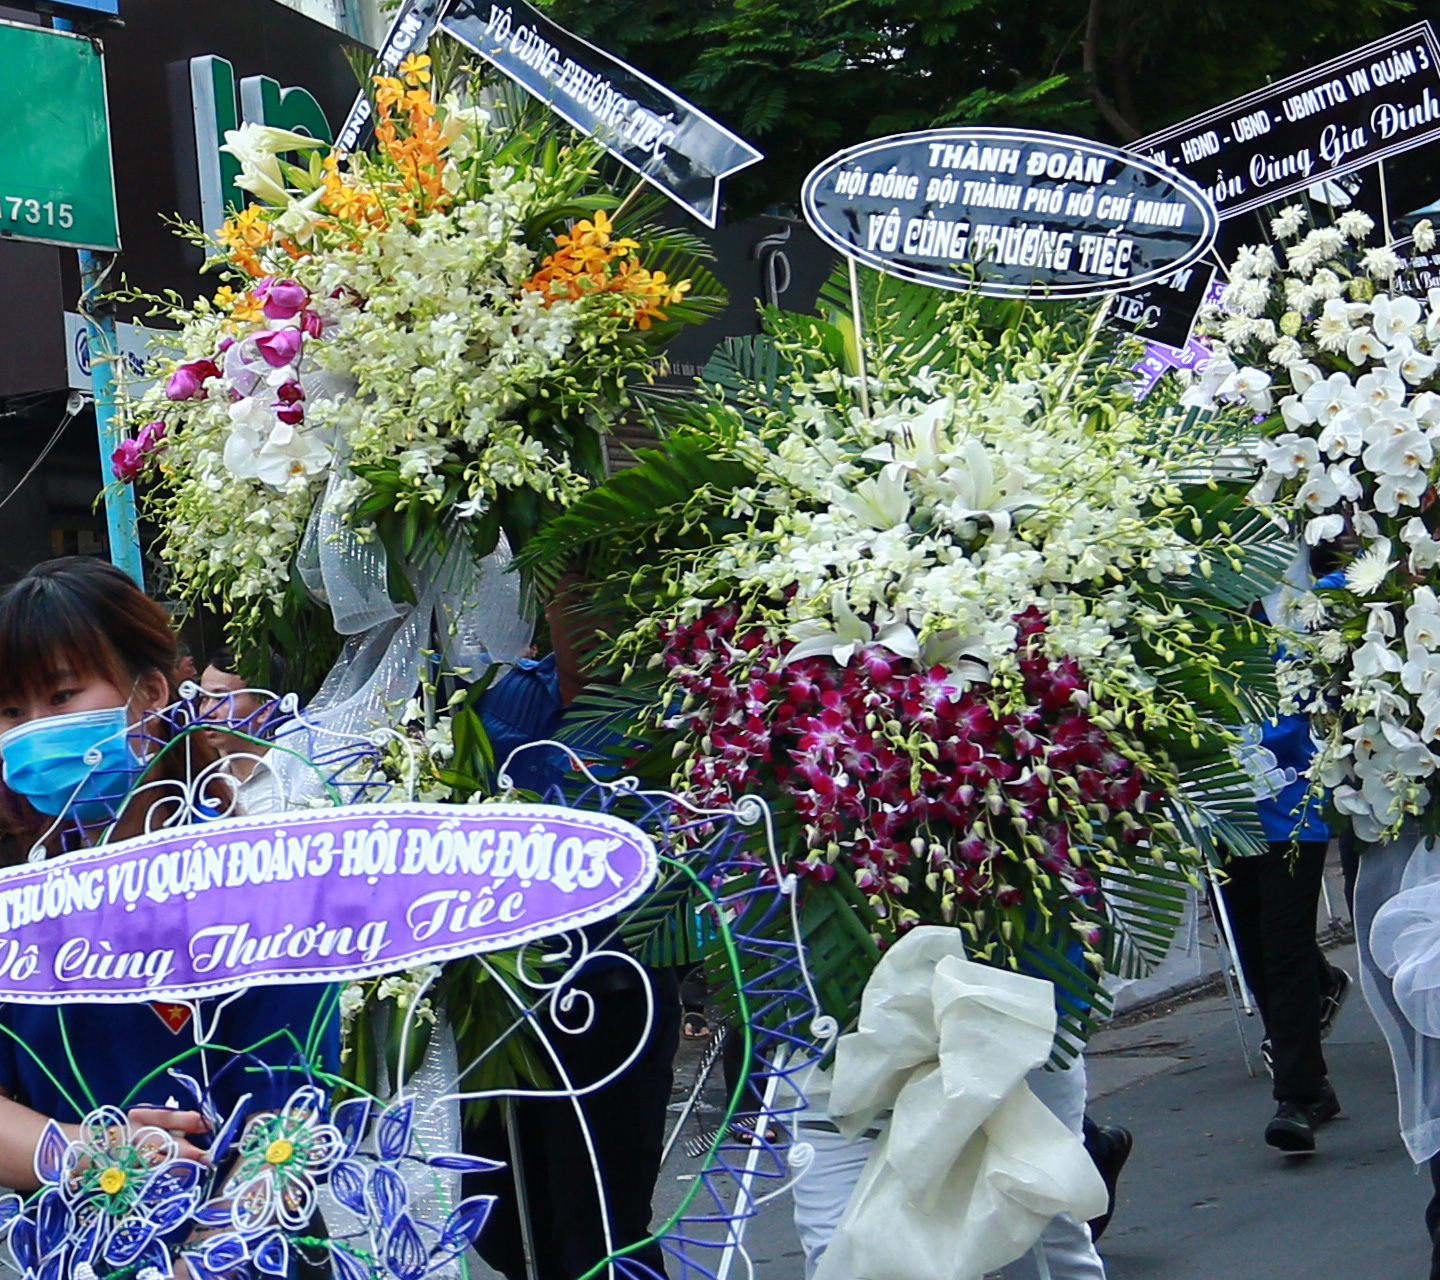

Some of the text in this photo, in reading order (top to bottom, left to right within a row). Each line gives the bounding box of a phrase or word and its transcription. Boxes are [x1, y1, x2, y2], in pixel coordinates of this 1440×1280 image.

[483, 3, 677, 162] VÔ CÙNG THƯƠNG TIẾC
[1230, 109, 1271, 144] UBND
[1281, 78, 1349, 123] UBMTTQ
[1347, 68, 1371, 97] VN
[1369, 50, 1418, 85] QUẬN
[1416, 44, 1430, 70] 3
[834, 165, 1187, 228] HỘI ĐỒNG ĐỘI THÀNH PHỐ HỒ CHÍ MINH
[927, 141, 1023, 175] THÀNH
[1201, 168, 1245, 205] uồn
[1249, 152, 1315, 188] Cùng
[1318, 123, 1369, 169] Gia
[866, 208, 1135, 279] VÔ CÙNG THƯƠNG TIẾC
[1113, 291, 1162, 329] IẾC
[106, 856, 148, 913] VỤ
[145, 839, 227, 904] QUẬN
[403, 817, 497, 876] ĐỒNG
[495, 822, 558, 889] ĐỘI
[551, 837, 608, 893] Q3
[54, 936, 175, 988] Cùng
[188, 918, 393, 974] Thương
[406, 878, 528, 942] Tiếc
